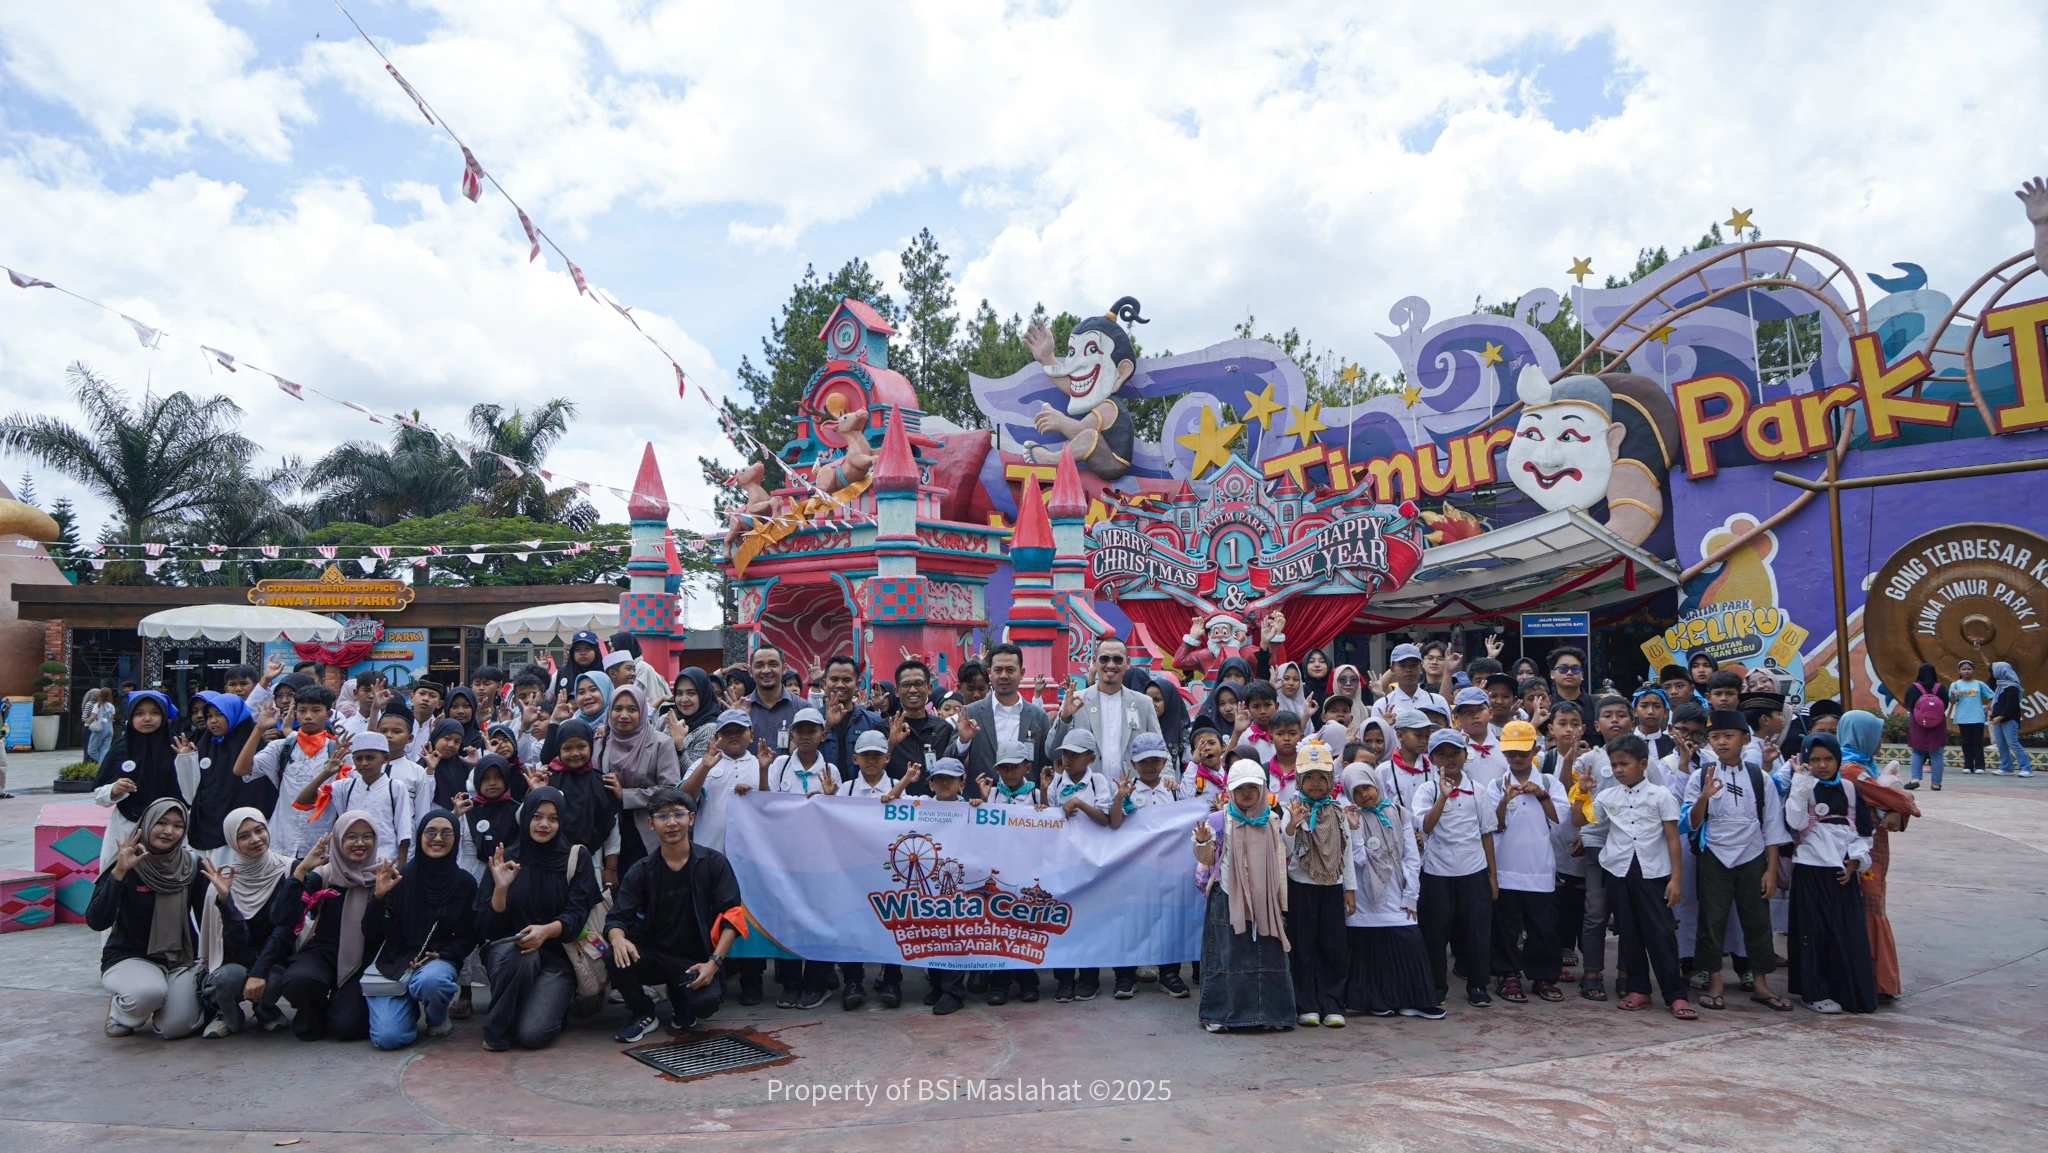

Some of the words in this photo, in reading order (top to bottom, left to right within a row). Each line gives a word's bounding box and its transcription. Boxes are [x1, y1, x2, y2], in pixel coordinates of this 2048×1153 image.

[1261, 426, 1515, 504] Timur
[1671, 332, 1958, 479] Park
[1202, 512, 1236, 537] JATIM
[1236, 512, 1267, 538] PARK
[1316, 517, 1386, 550] HAPPY
[1102, 528, 1150, 556] MERRY
[1223, 537, 1243, 569] 1
[1092, 549, 1199, 589] CHRISTMAS
[1271, 554, 1315, 583] NEW
[1320, 539, 1389, 578] YEAR
[1885, 558, 1928, 601] GONG
[1922, 539, 2032, 570] TERBESAR
[266, 584, 319, 592] COSTUMER
[320, 584, 363, 592] SERVICE
[363, 584, 396, 592] OFFICE
[267, 596, 304, 606] JAWA
[307, 596, 350, 606] TIMUR
[354, 596, 397, 606] PARK1
[1223, 583, 1249, 611] &
[1685, 603, 1718, 620] JATIM
[1722, 599, 1751, 612] PARK
[1918, 599, 1946, 636] JAWA
[1937, 579, 1989, 602] TIMUR
[1993, 583, 2036, 620] PARK
[2021, 621, 2041, 631] 1
[1665, 607, 1779, 650] KELIRU
[1705, 639, 1743, 653] KEJUTAN
[1732, 643, 1756, 655] SERU
[884, 804, 915, 821] BSI
[918, 816, 952, 824] INDONESIA
[975, 808, 1006, 826] BSI
[1008, 817, 1066, 829] MASLAHAT
[870, 891, 982, 920] Wisata
[989, 894, 1069, 926] Ceria
[895, 924, 951, 942] Berbagi
[954, 922, 1048, 945] Kebahagiaan
[902, 940, 963, 956] Bersama
[965, 939, 1002, 952] Anak
[1004, 939, 1044, 960] Yatim
[928, 961, 1006, 969] www.bsimaslahat.or.id
